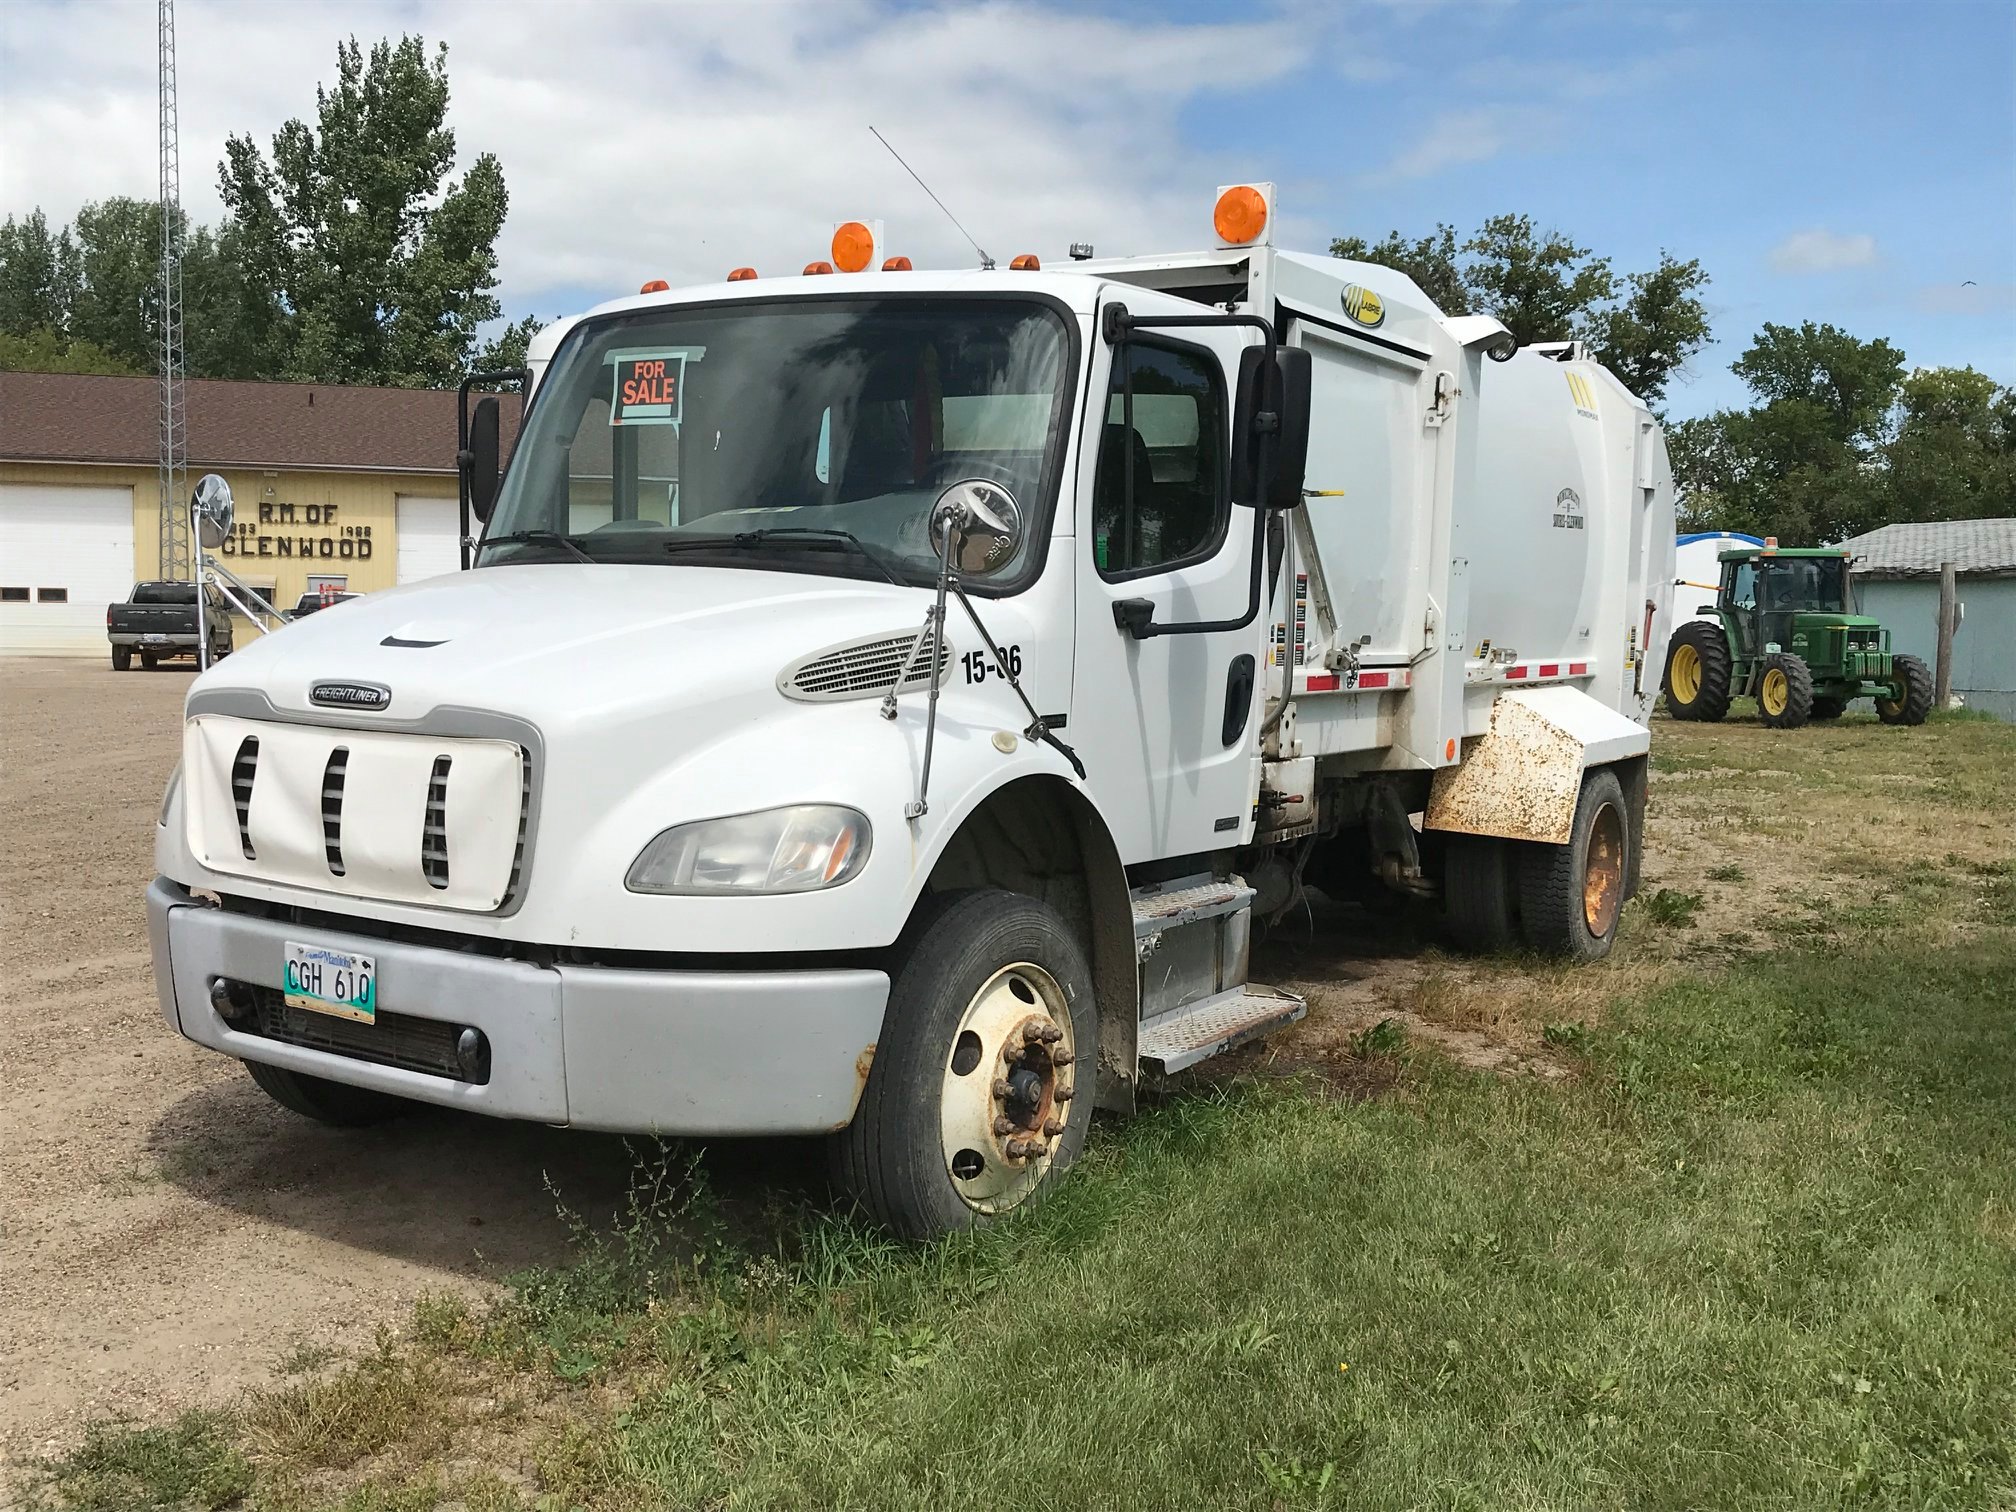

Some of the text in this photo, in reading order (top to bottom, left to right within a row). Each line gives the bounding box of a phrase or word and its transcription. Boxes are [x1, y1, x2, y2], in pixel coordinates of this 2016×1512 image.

[634, 361, 665, 379] FOR
[622, 378, 675, 404] SALE
[258, 502, 338, 525] R.M. OF
[230, 522, 256, 535] 883
[340, 525, 372, 537] 1988
[221, 535, 372, 560] GLENWOOD
[315, 687, 379, 702] FREIGHTLINER
[287, 959, 370, 1004] CGH 610
